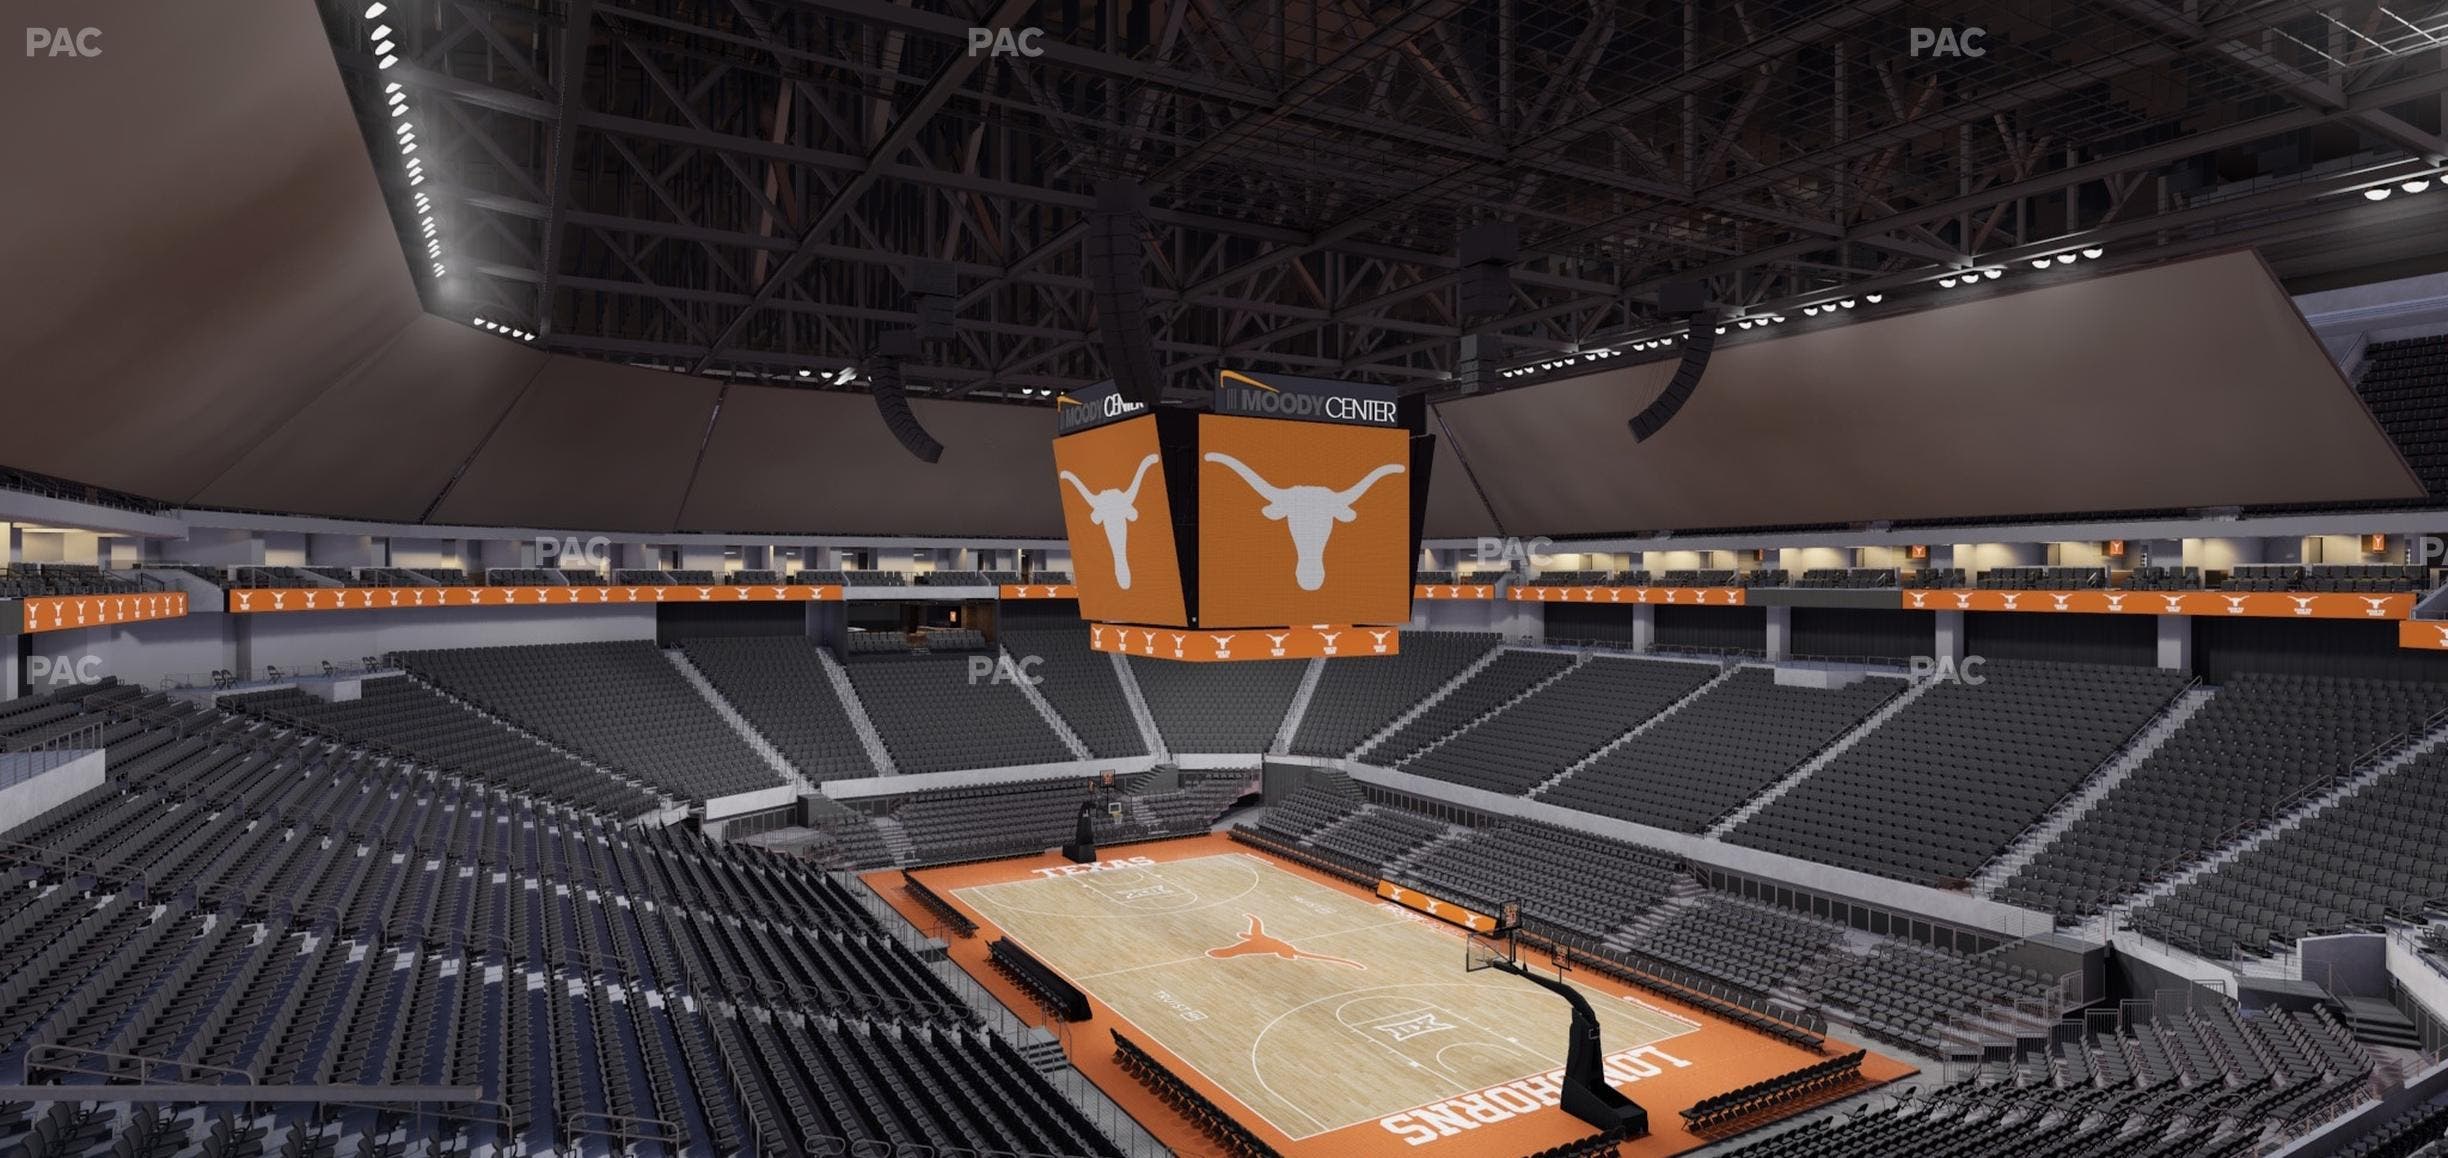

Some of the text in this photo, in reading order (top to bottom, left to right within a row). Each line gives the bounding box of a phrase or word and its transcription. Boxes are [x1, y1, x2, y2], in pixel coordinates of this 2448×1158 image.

[1241, 388, 1397, 422] MOODY CENTER
[1032, 856, 1156, 878] TEXAS
